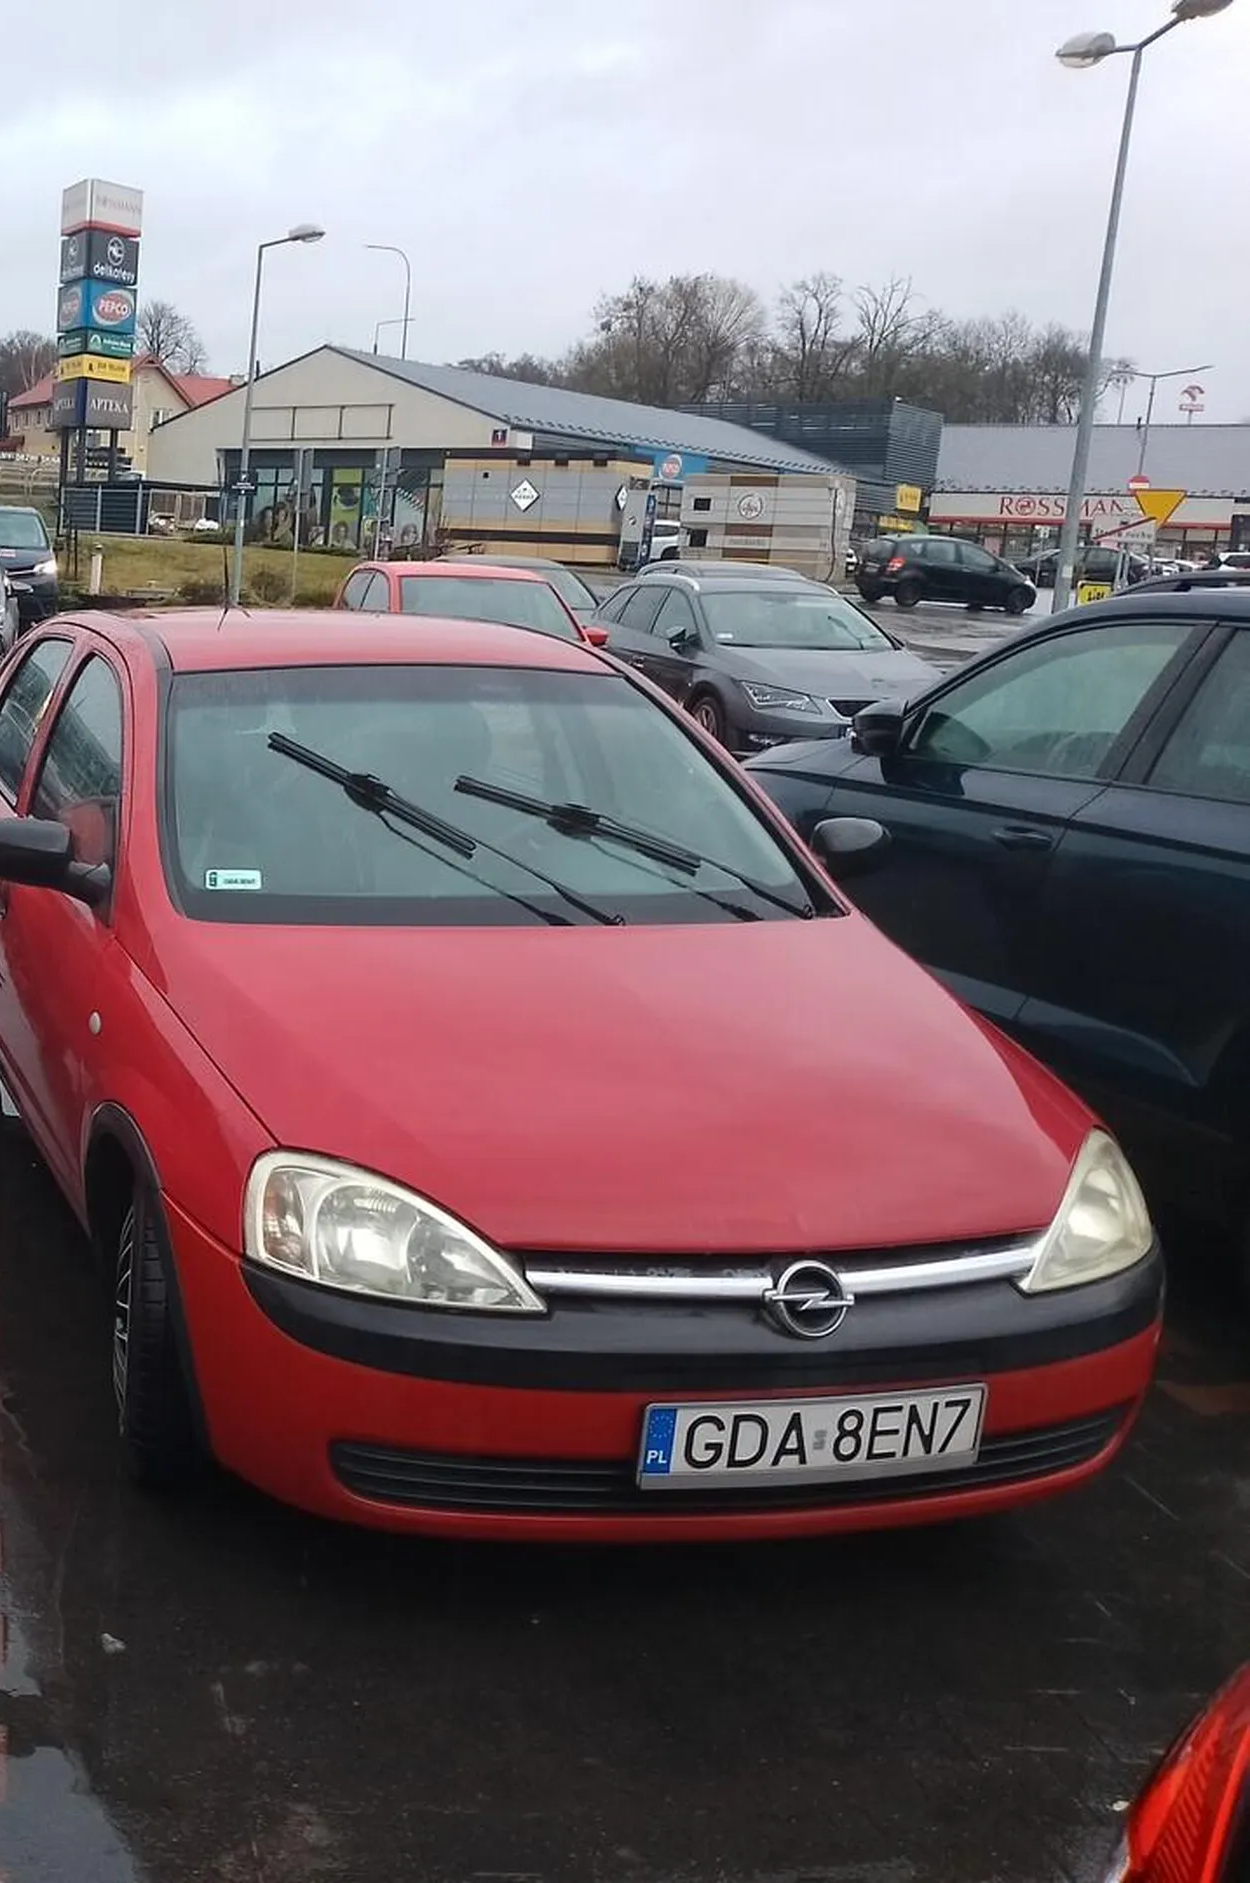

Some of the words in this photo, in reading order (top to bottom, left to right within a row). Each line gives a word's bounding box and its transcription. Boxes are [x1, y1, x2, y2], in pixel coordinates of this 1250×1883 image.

[99, 297, 128, 316] PEPCO
[90, 399, 129, 414] APTEKA
[684, 1411, 808, 1470] GDA
[832, 1398, 972, 1463] 8EN7
[646, 1449, 668, 1465] PL
